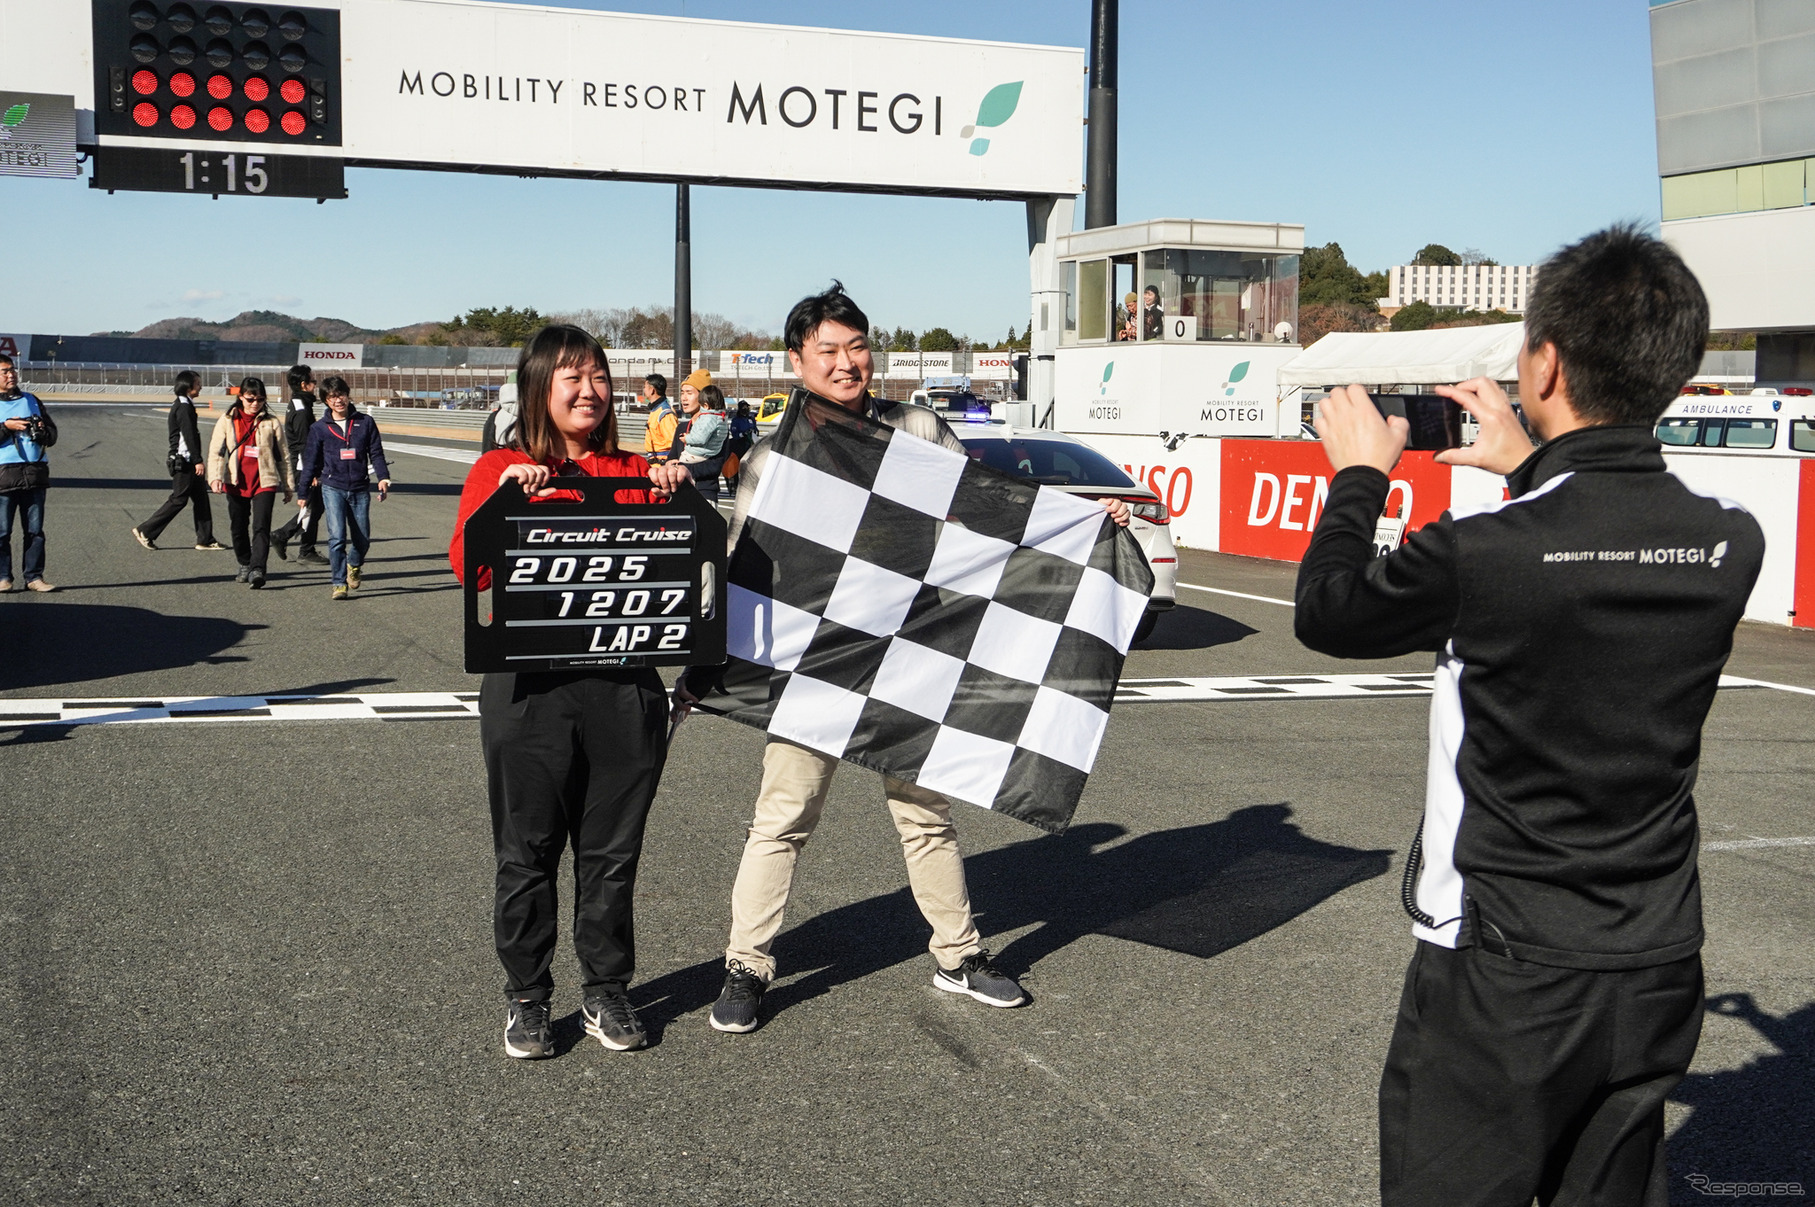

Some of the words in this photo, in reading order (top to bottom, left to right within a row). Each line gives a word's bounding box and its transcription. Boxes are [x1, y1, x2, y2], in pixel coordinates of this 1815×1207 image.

[399, 69, 563, 104] MOBILITY
[583, 81, 706, 112] RESORT
[727, 80, 941, 136] MOTEGI
[180, 152, 268, 194] 1:15
[304, 351, 356, 359] HONDA
[978, 359, 1013, 367] HON
[1088, 406, 1121, 420] MOTEGI
[1200, 408, 1264, 421] MOTEGI
[1682, 404, 1753, 414] AMBULANCE
[1247, 472, 1413, 532] DENO
[526, 528, 610, 543] Circuit
[615, 527, 692, 542] Cruise
[1543, 551, 1595, 562] MOBILITY
[1598, 551, 1635, 561] RESORT
[1639, 548, 1705, 564] MOTEGI
[509, 556, 648, 583] 2025
[558, 589, 685, 617] 1207
[588, 625, 651, 652] LAP
[657, 624, 687, 649] 2
